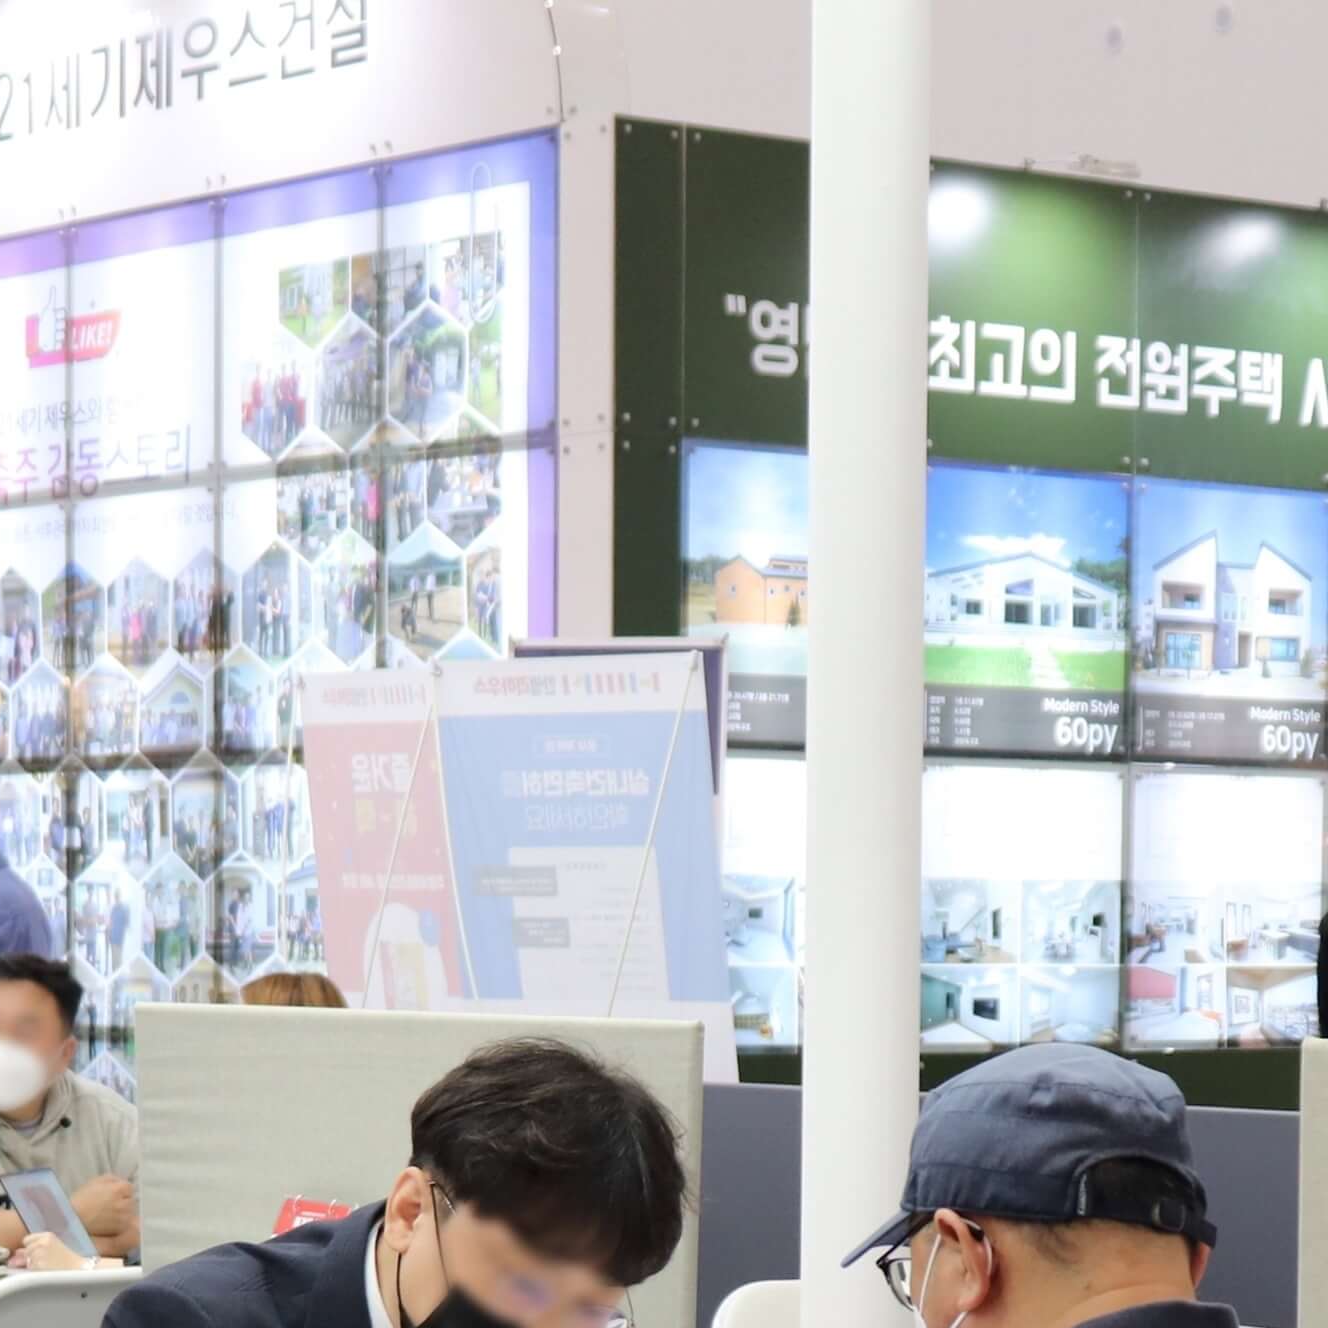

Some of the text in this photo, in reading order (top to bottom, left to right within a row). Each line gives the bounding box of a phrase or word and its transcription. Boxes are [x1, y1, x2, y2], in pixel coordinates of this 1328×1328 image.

[72, 321, 114, 350] LIKE!
[928, 315, 1077, 402] 최고의
[1094, 335, 1283, 423] 전원주택
[1043, 696, 1119, 716] Modern Style
[1250, 706, 1321, 723] Modern Style
[1054, 716, 1118, 753] 60py
[1262, 724, 1319, 760] 60py
